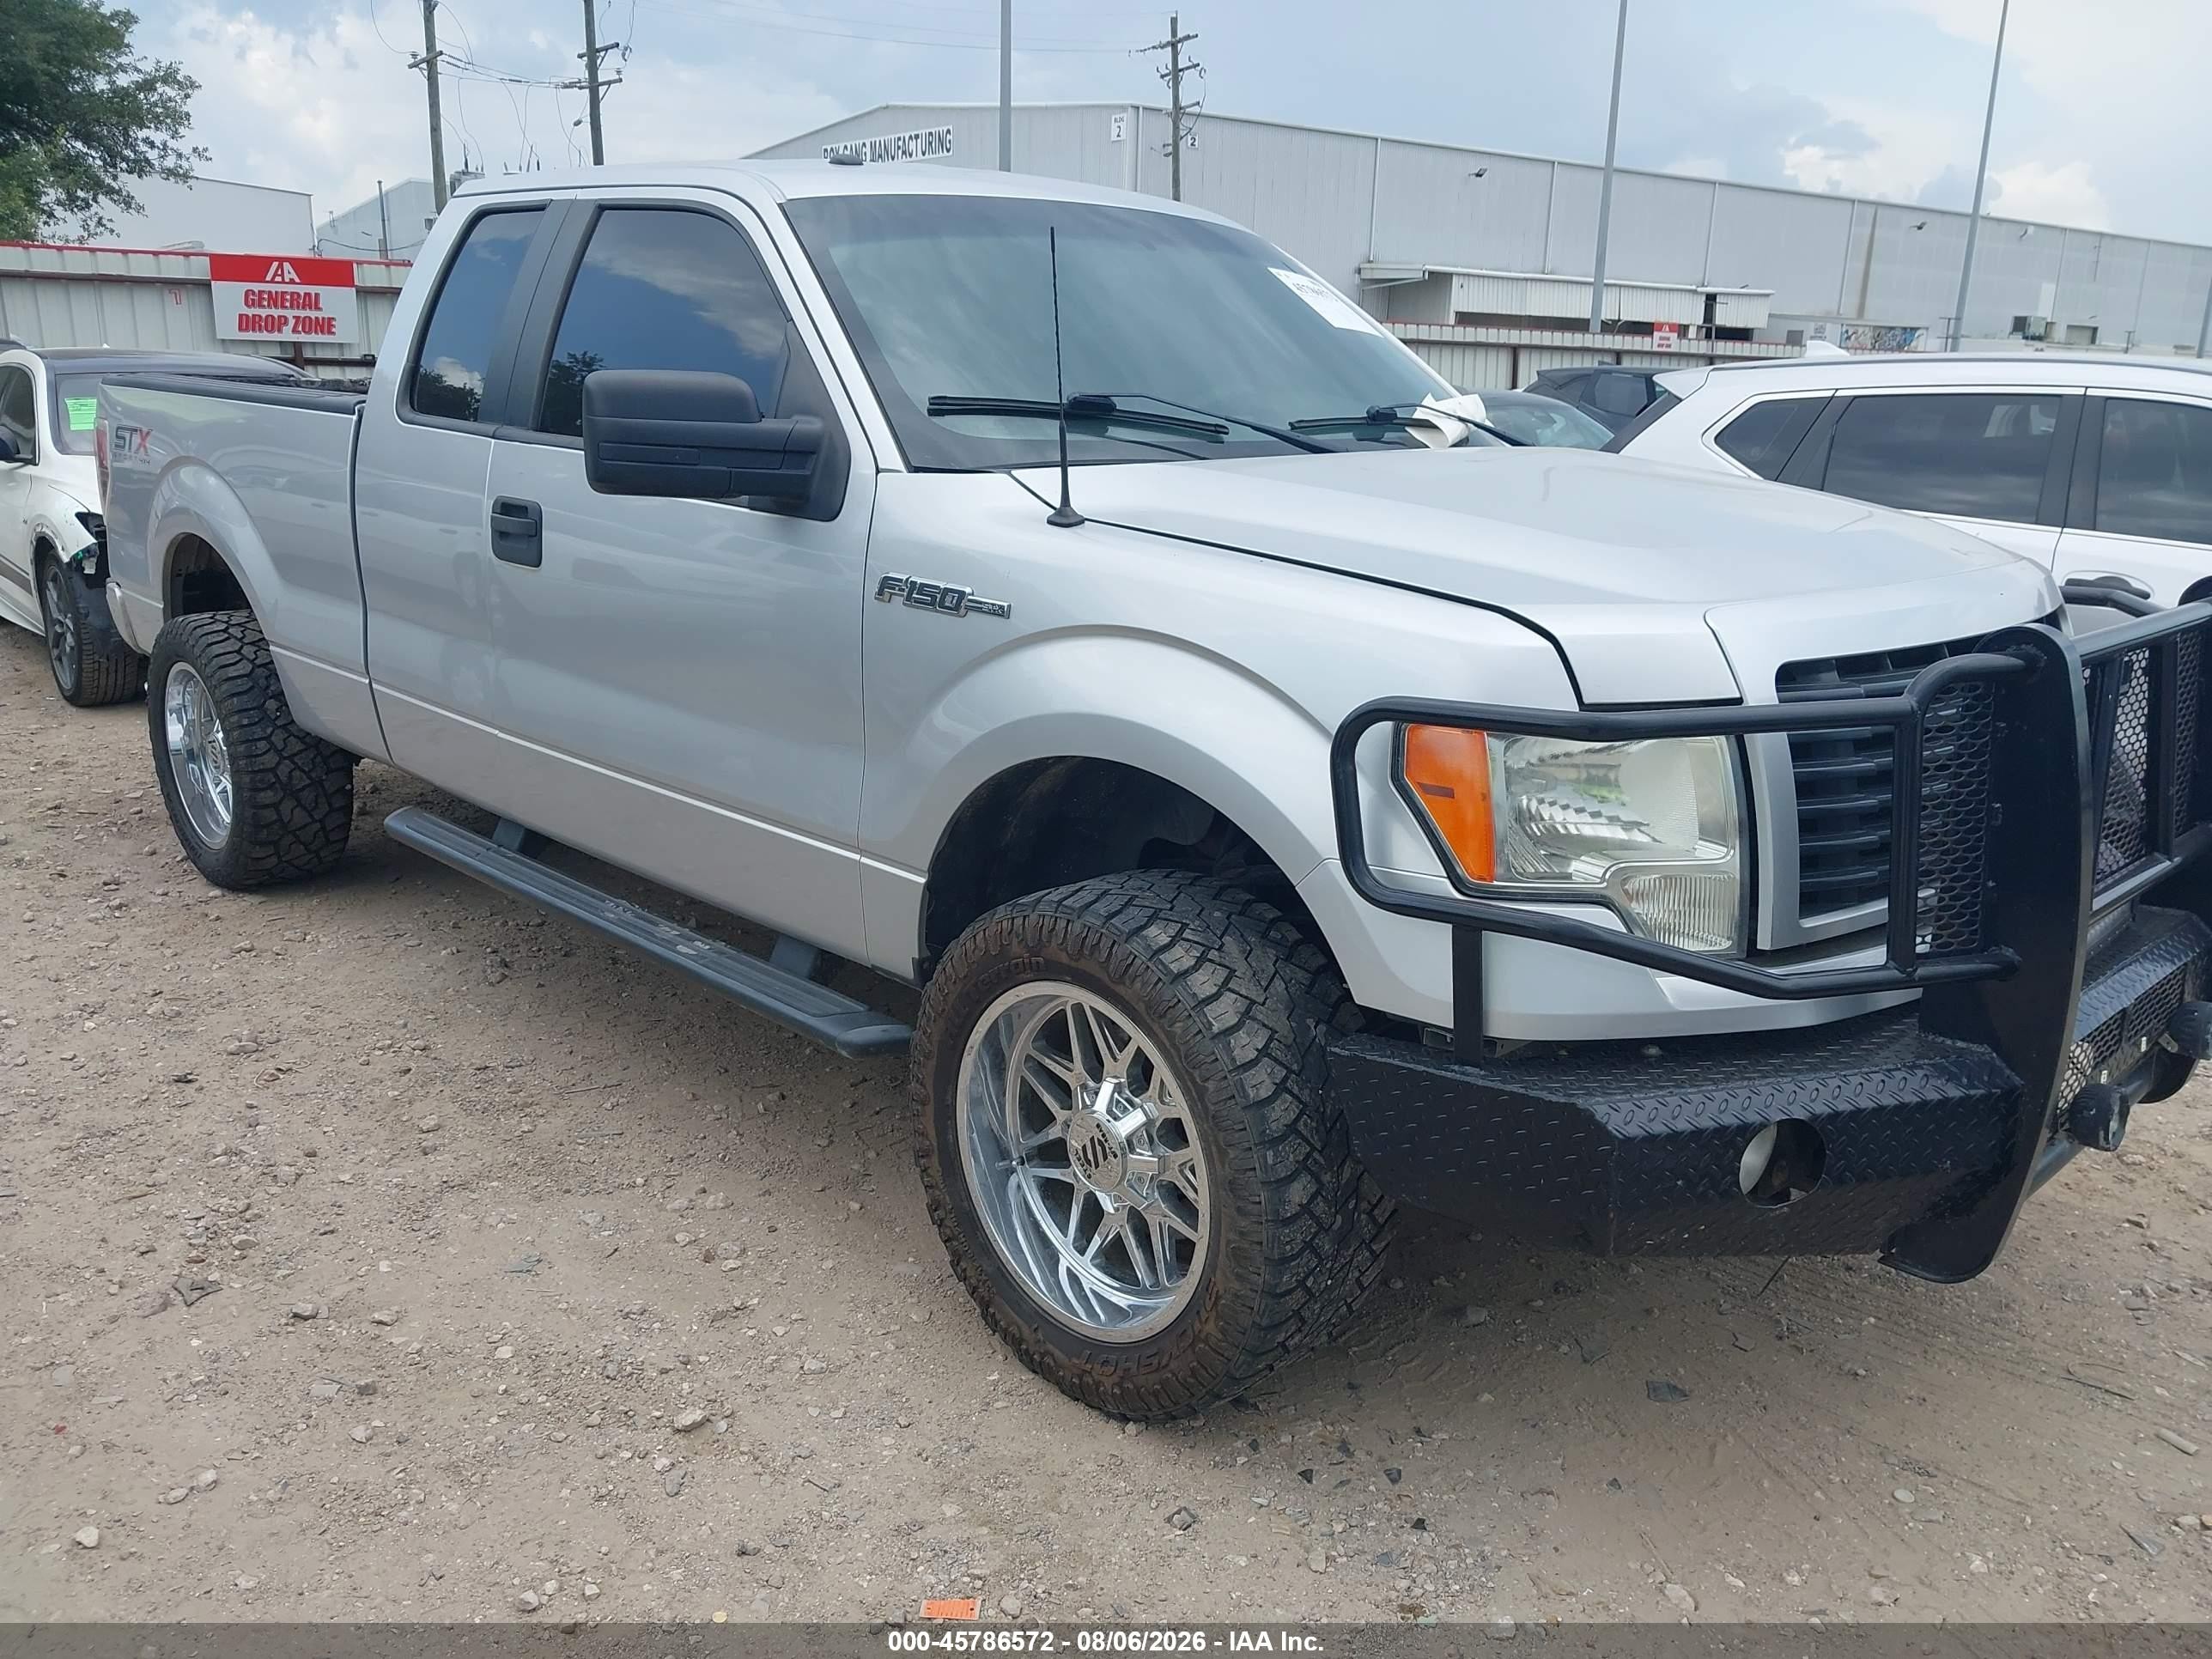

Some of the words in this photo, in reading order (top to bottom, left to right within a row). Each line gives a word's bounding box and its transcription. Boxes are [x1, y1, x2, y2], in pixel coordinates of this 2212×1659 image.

[1116, 125, 1121, 137] 2
[1190, 137, 1196, 147] 2
[869, 128, 952, 163] MANUFACTURING
[244, 289, 323, 312] GENERAL
[238, 313, 289, 335] DROP
[292, 315, 337, 337] ZONE
[113, 424, 154, 456] STX
[1074, 1148, 1092, 1180] STEEL
